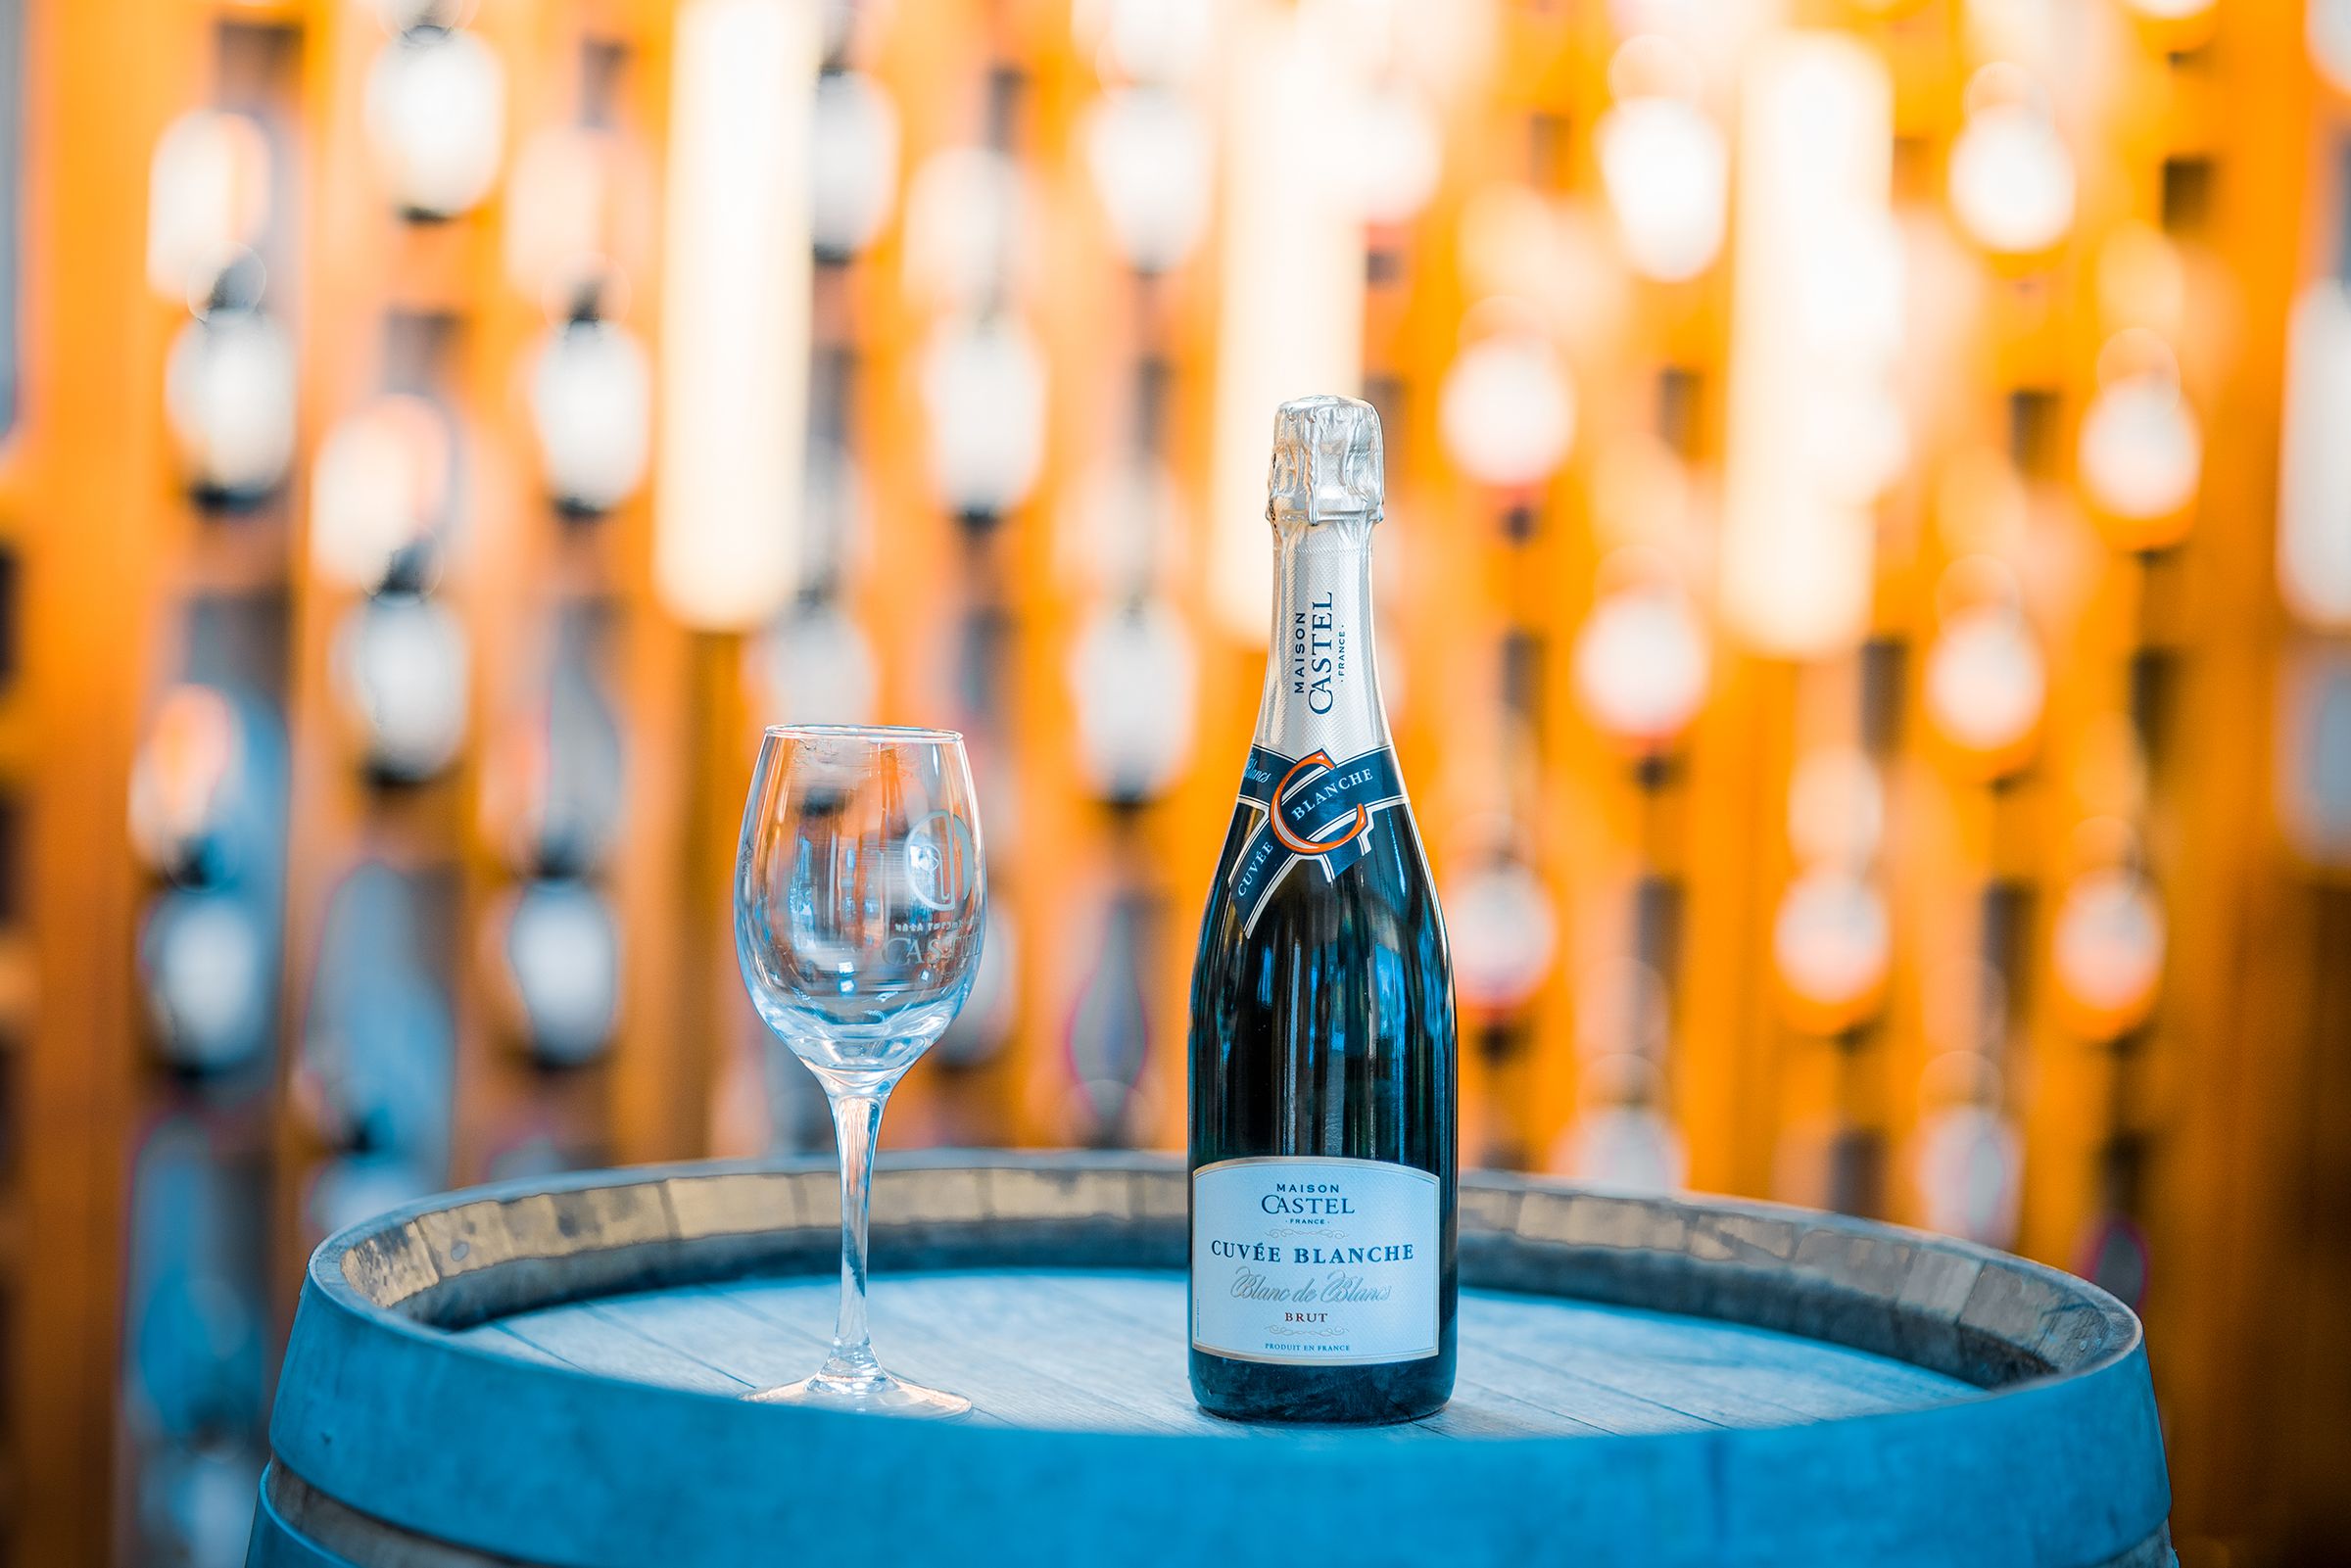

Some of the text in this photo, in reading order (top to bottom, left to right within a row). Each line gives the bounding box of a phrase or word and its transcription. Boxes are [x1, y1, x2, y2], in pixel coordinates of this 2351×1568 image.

[1294, 612, 1306, 693] MAISON
[1308, 592, 1333, 715] CASTEL
[1237, 767, 1374, 897] CUVÉE BLANCHE
[1276, 1183, 1340, 1194] MAISON
[1261, 1194, 1356, 1214] CASTEL
[1211, 1239, 1415, 1264] CUVÉE BLANCHE
[1230, 1265, 1392, 1305] Blanc de Blancs
[1284, 1311, 1328, 1323] BRUT
[1265, 1343, 1301, 1352] PRODUIT
